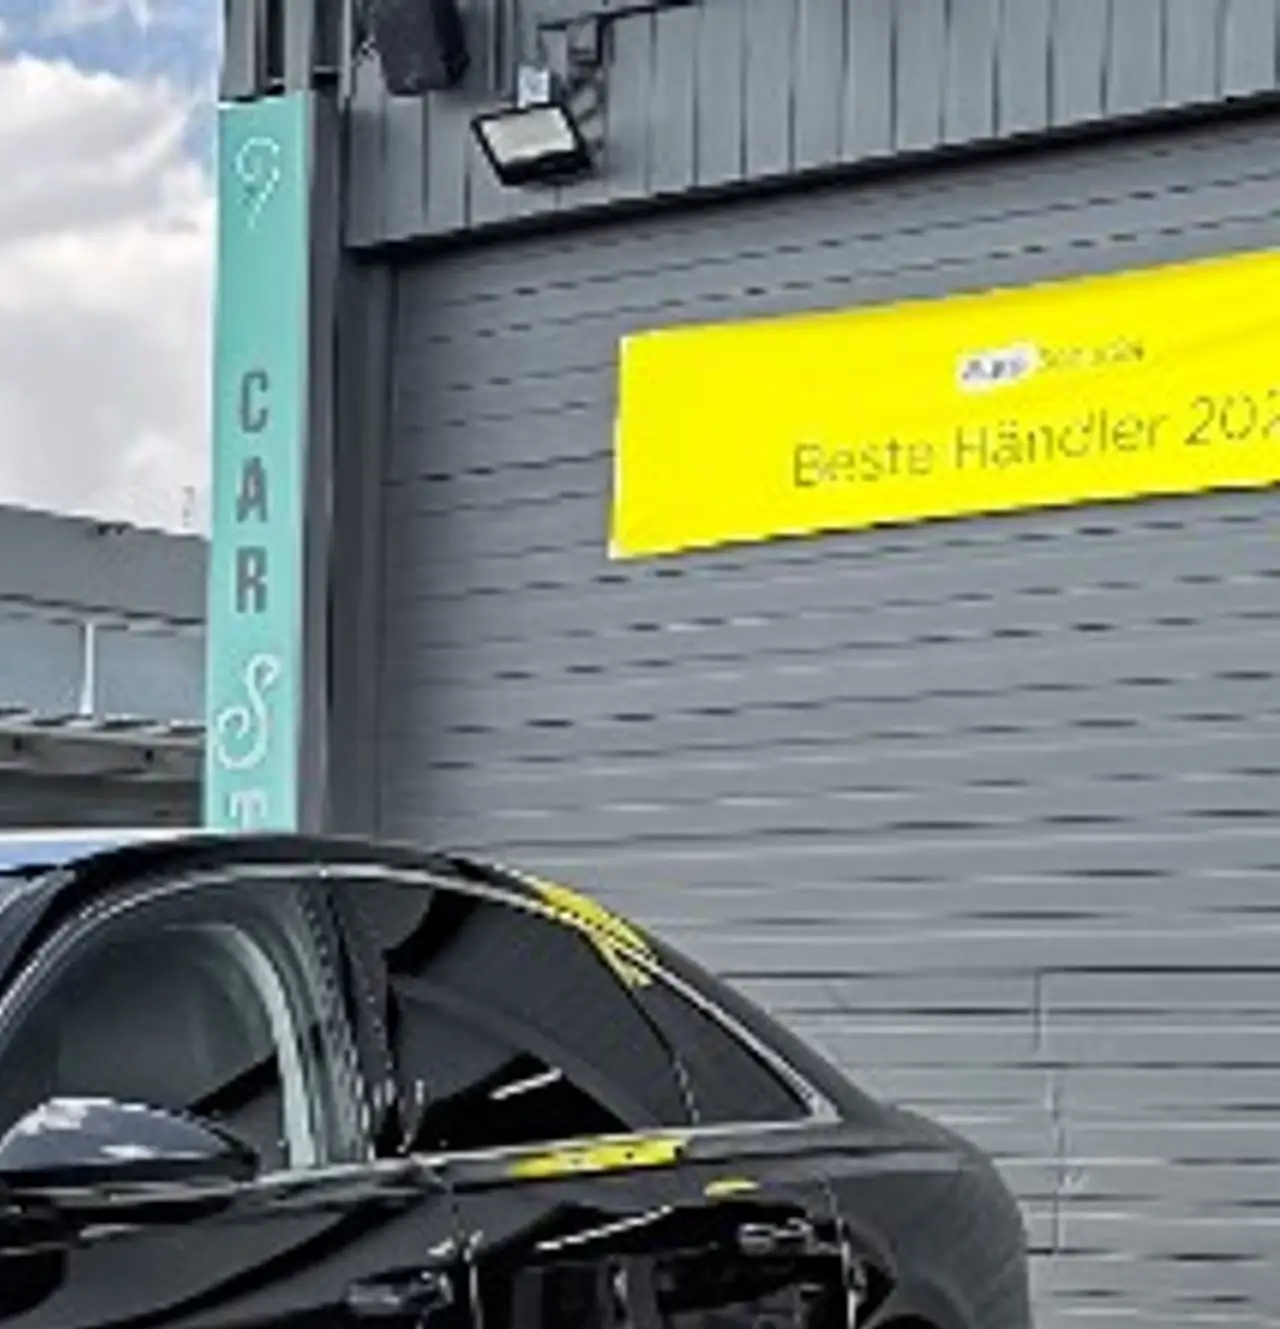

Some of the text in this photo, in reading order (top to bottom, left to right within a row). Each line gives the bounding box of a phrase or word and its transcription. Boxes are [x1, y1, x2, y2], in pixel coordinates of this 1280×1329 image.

[235, 368, 269, 614] CAR
[793, 437, 934, 488] Beste
[955, 407, 1169, 470] Händler
